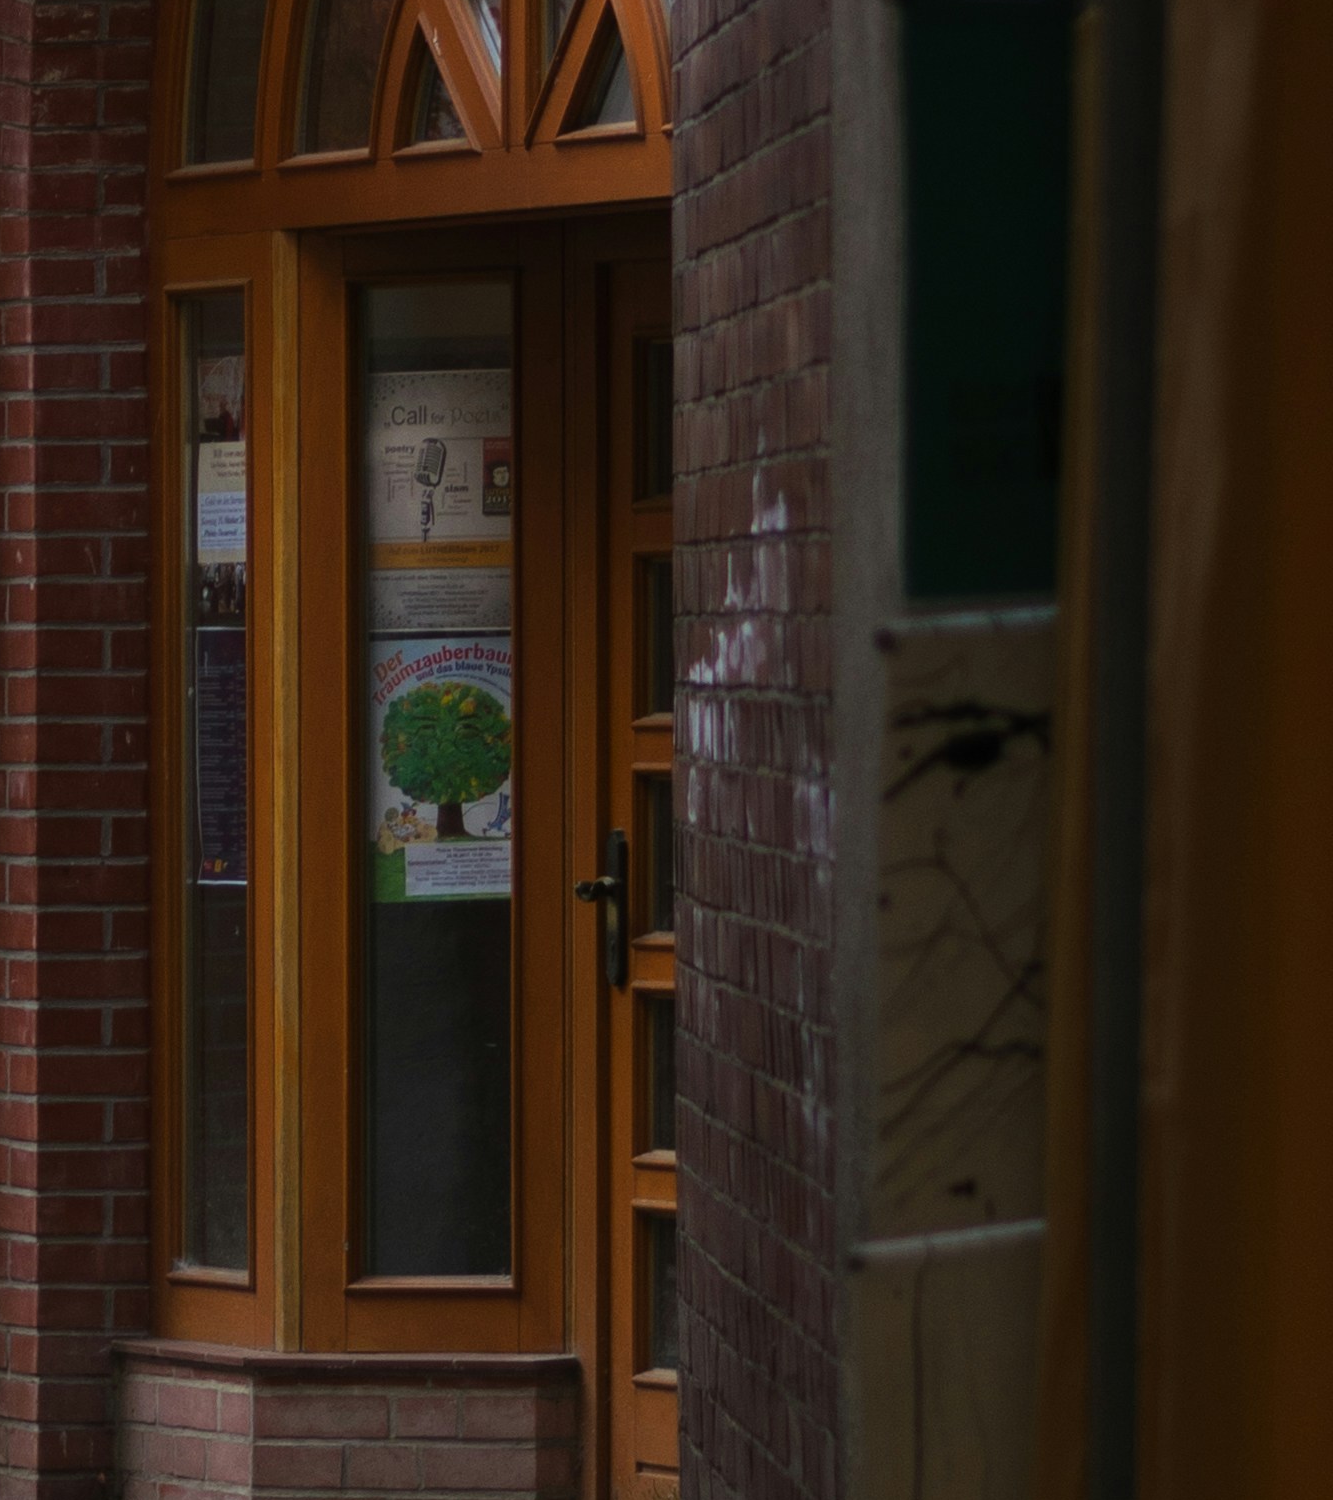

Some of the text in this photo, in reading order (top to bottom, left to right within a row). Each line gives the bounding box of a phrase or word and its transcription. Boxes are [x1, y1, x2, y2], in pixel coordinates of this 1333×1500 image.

[385, 445, 415, 454] poetry
[444, 484, 469, 493] slam
[373, 648, 403, 683] Der
[415, 667, 434, 682] und
[436, 663, 454, 674] das
[455, 661, 484, 671] blaue
